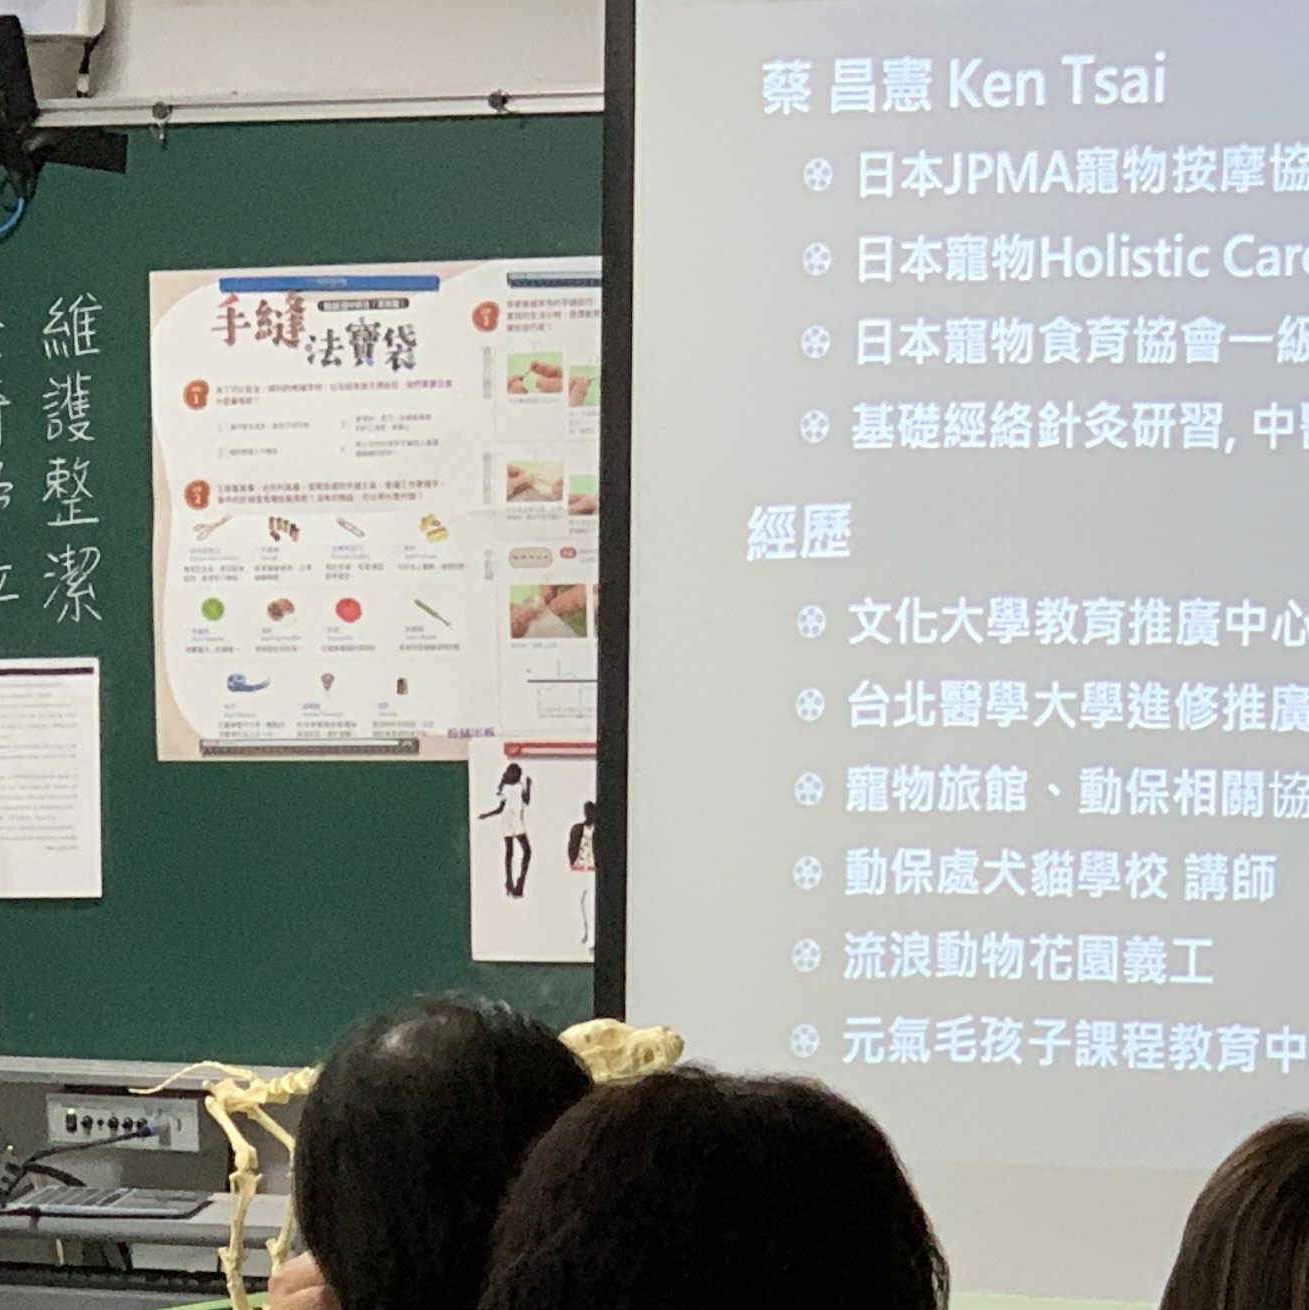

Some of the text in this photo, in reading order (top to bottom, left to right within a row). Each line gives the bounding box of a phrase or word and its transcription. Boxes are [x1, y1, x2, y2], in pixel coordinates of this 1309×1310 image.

[762, 50, 1168, 115] 蔡 昌憲 Ken Tsai
[856, 231, 1210, 284] 日本寵物Holistic
[851, 400, 1236, 454] 基礎經絡針灸研習,
[42, 292, 103, 624] 維護整潔
[745, 501, 853, 561] 經歷
[843, 847, 1278, 902] 動保處犬貓學校 講師
[842, 930, 1215, 986] 流浪動物花園義工
